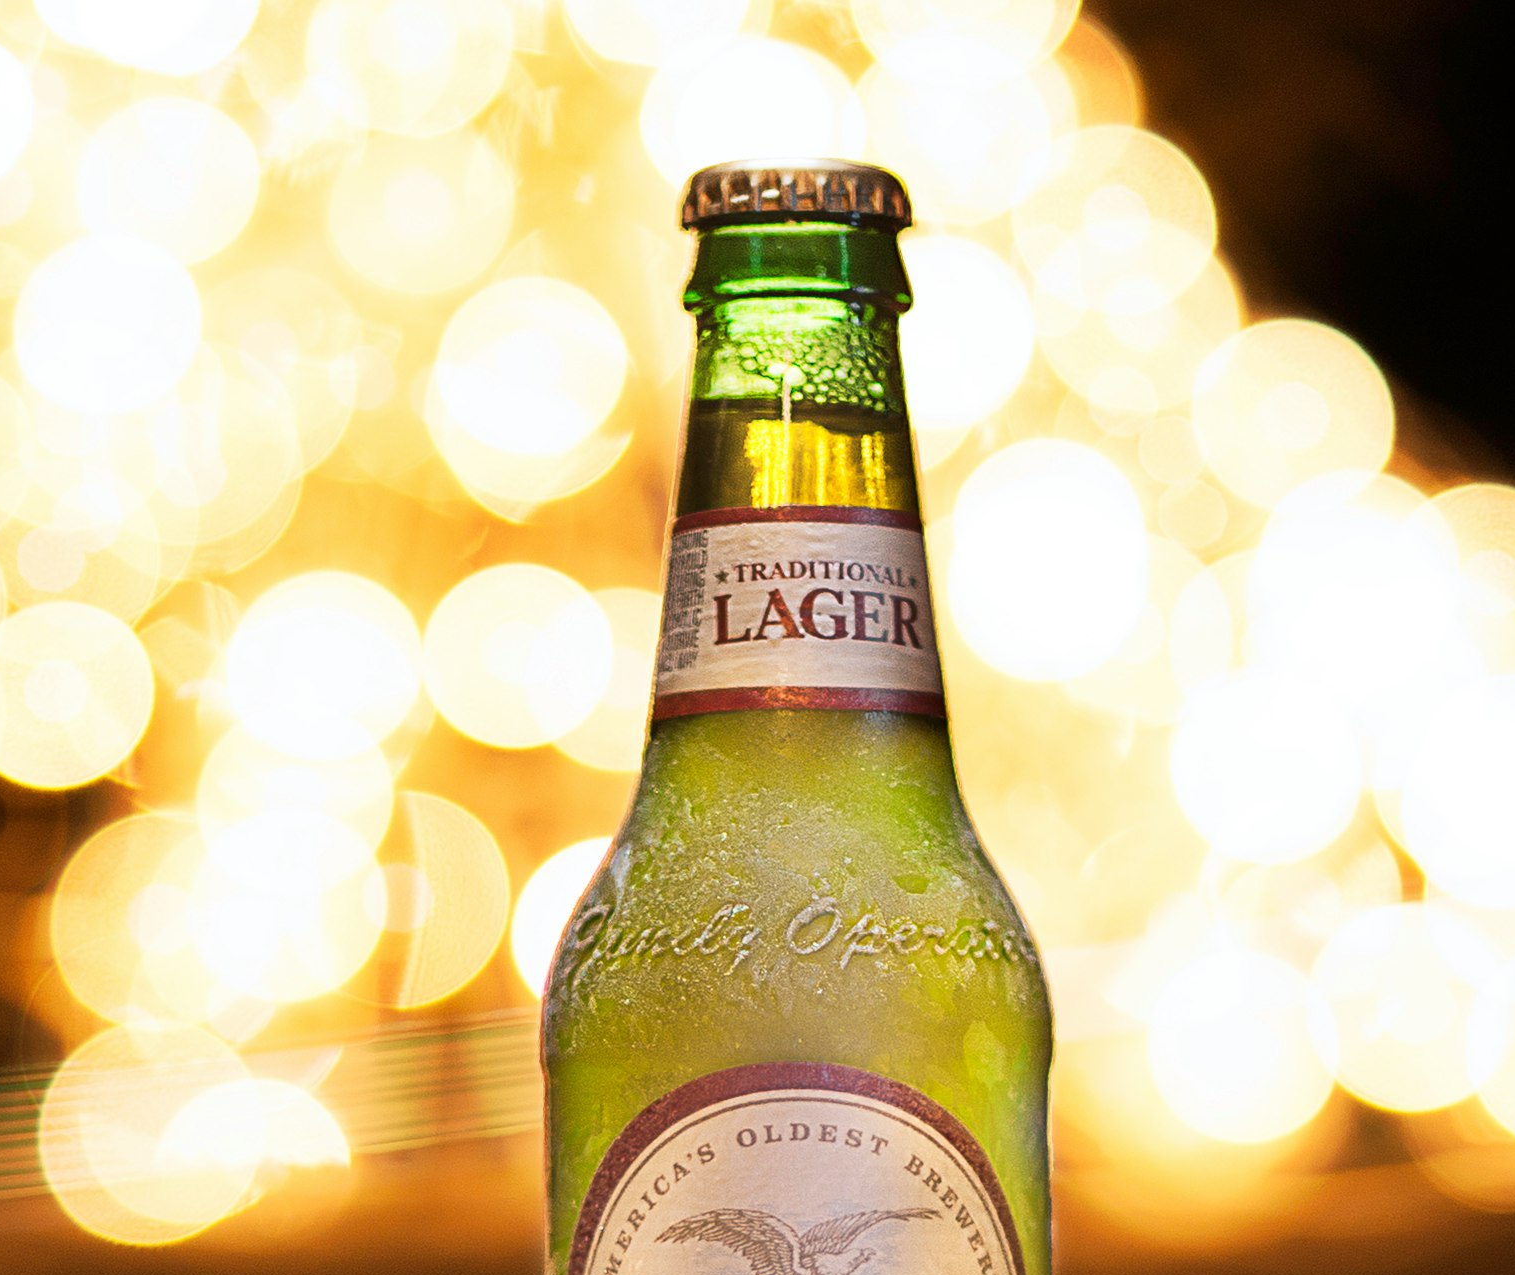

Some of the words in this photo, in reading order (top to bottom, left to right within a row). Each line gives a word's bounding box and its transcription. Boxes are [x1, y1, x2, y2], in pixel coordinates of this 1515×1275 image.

[734, 560, 906, 588] TRADITIONAL
[713, 587, 924, 649] LAGER
[736, 1122, 889, 1155] OLDEST
